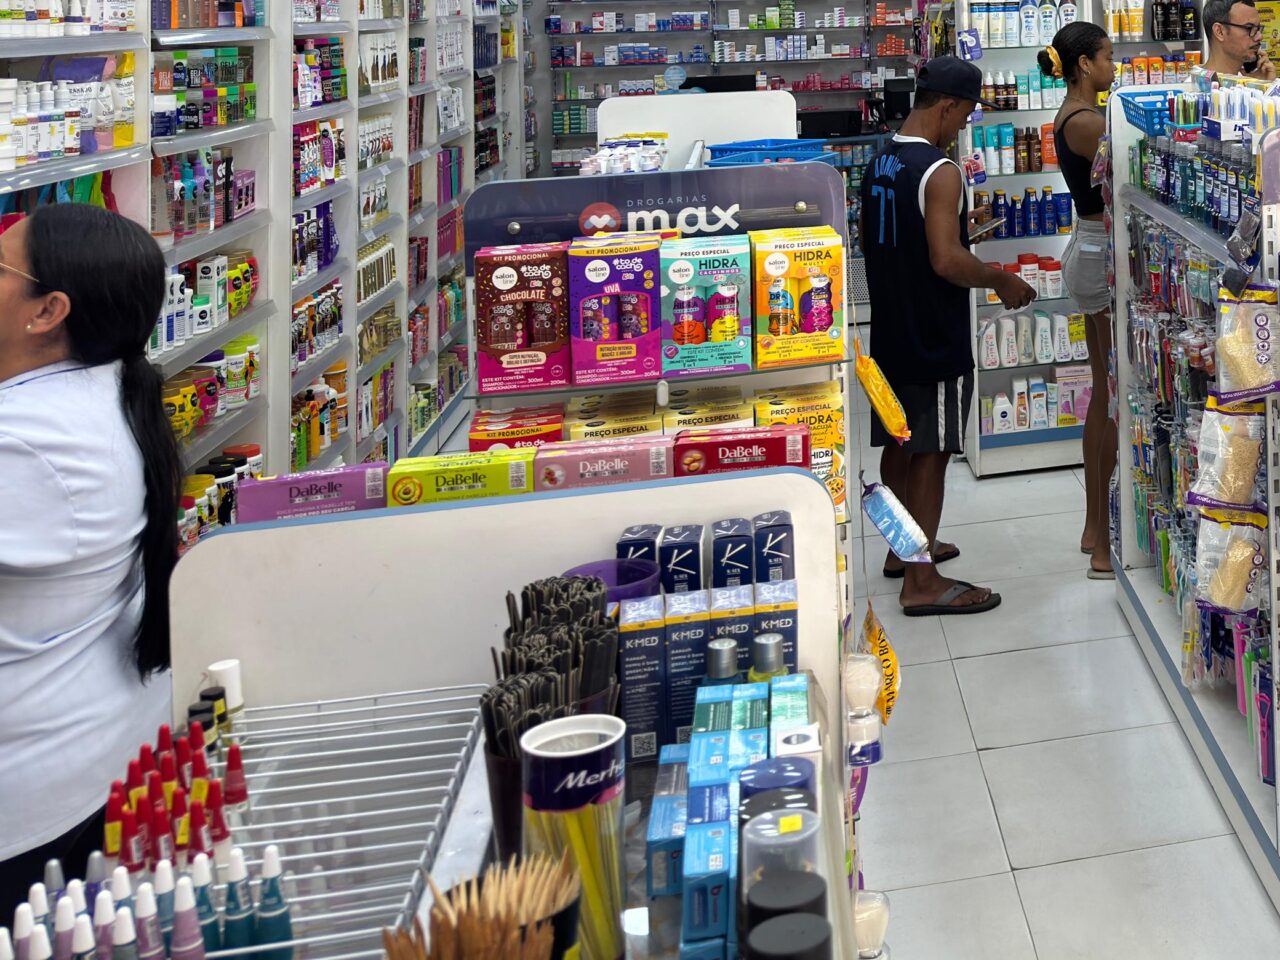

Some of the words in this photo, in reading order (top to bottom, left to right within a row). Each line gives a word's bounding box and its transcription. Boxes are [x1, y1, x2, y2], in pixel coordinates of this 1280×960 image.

[626, 194, 707, 207] DROGARIAS
[627, 203, 740, 234] max
[597, 246, 640, 254] PROMOCIONAL
[505, 253, 549, 261] PROMOCIONAL
[500, 290, 545, 301] CHOCOLATE
[604, 285, 620, 293] UVA
[677, 417, 701, 425] PREÇO
[703, 412, 741, 423] ESPECIAL
[584, 429, 610, 438] PREÇO
[612, 425, 649, 436] ESPECIAL
[718, 446, 766, 458] DaBelle
[579, 459, 629, 472] DaBelle
[289, 479, 342, 498] DaBelle
